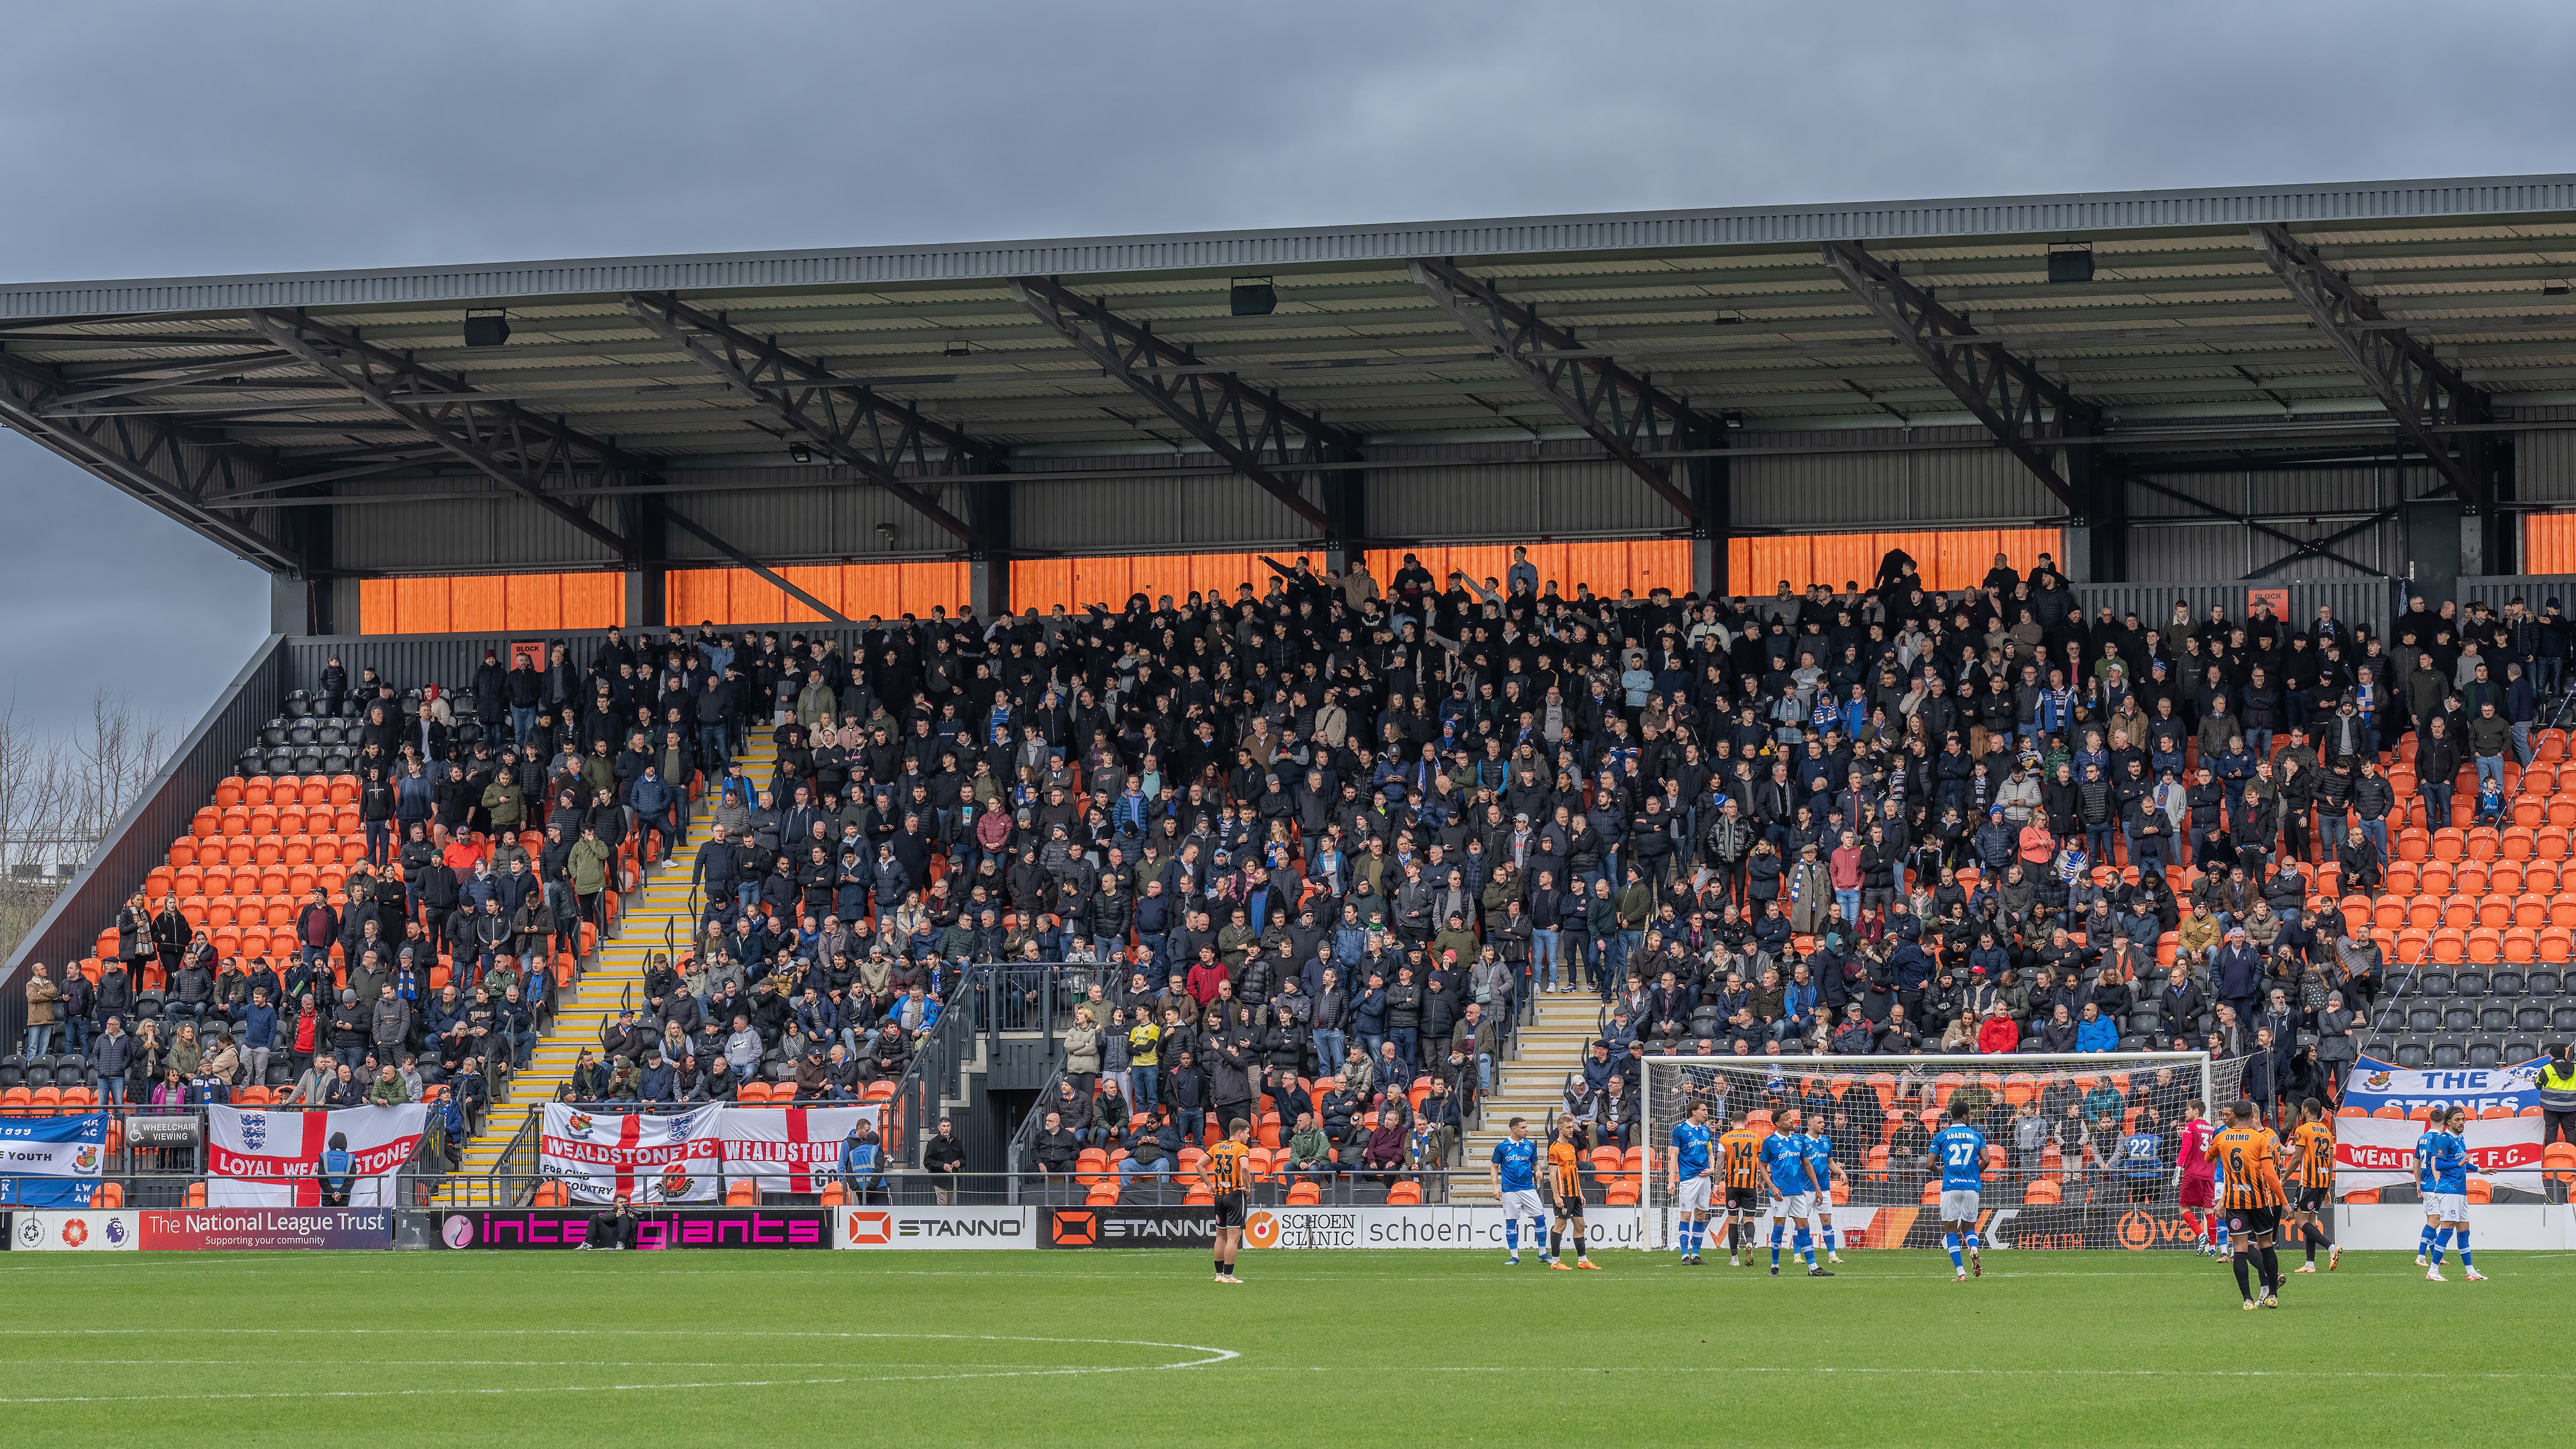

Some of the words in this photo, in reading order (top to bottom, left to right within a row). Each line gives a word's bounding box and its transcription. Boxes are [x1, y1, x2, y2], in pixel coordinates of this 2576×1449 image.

[2422, 1072, 2489, 1089] THE
[82, 1118, 99, 1127] NR
[143, 1123, 197, 1131] WHEELCHAIR
[80, 1128, 98, 1137] AC
[1947, 1132, 1974, 1140] ADARKWA
[2130, 1139, 2151, 1157] 22
[2199, 1132, 2214, 1152] 3
[2313, 1136, 2330, 1159] 22
[8, 1151, 53, 1161] YOUTH
[548, 1138, 683, 1164] WEALDSTONE
[687, 1140, 713, 1158] FC
[1731, 1142, 1753, 1161] 14
[1948, 1143, 1974, 1166] 27
[2487, 1148, 2526, 1166] F.C.
[219, 1152, 276, 1175] LOYAL
[282, 1141, 411, 1179] WEASTONE
[1214, 1153, 1234, 1175] 33
[2230, 1146, 2243, 1173] 6
[543, 1164, 562, 1174] FOR
[76, 1184, 92, 1192] LW
[565, 1181, 614, 1195] COUNTRY
[677, 1183, 691, 1196] FORGET
[74, 1194, 91, 1203] AH
[21, 1217, 44, 1227] PROFESSONAL
[149, 1214, 180, 1234] The
[186, 1212, 262, 1234] National
[267, 1214, 333, 1236] League
[337, 1212, 384, 1231] Trust
[898, 1219, 1022, 1237] STANNO
[1281, 1214, 1356, 1230] SCHOEN
[1369, 1216, 1644, 1242] schoen-cin.o.uk
[205, 1236, 254, 1247] Supporting
[254, 1237, 275, 1247] your
[276, 1236, 325, 1247] community
[1281, 1231, 1355, 1247] CLINIC
[1849, 1235, 1861, 1244] FIRE
[2018, 1233, 2083, 1250] HEALTH
